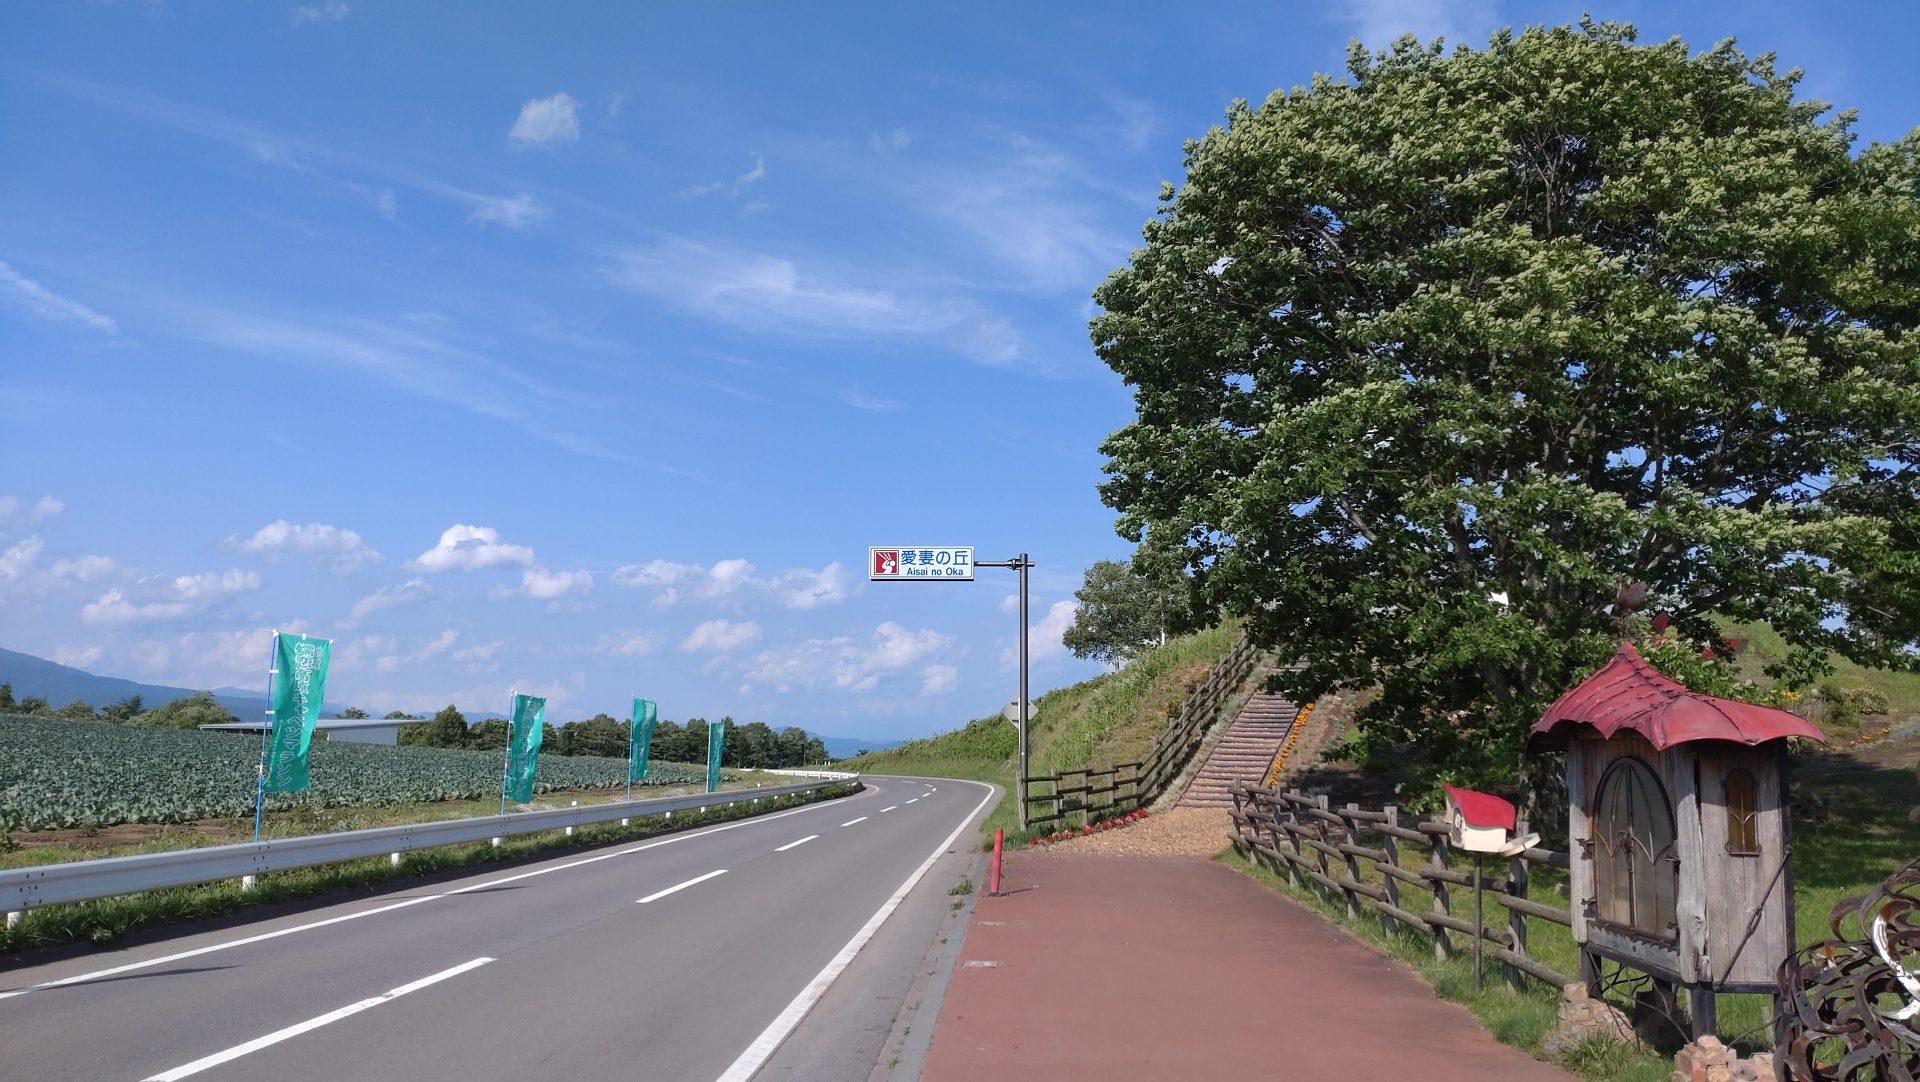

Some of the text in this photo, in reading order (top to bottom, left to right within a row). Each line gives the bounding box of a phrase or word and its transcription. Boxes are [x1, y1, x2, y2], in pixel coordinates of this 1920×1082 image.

[901, 550, 969, 566] 愛妻の丘
[907, 567, 928, 576] Aisai
[946, 567, 964, 576] Oka
